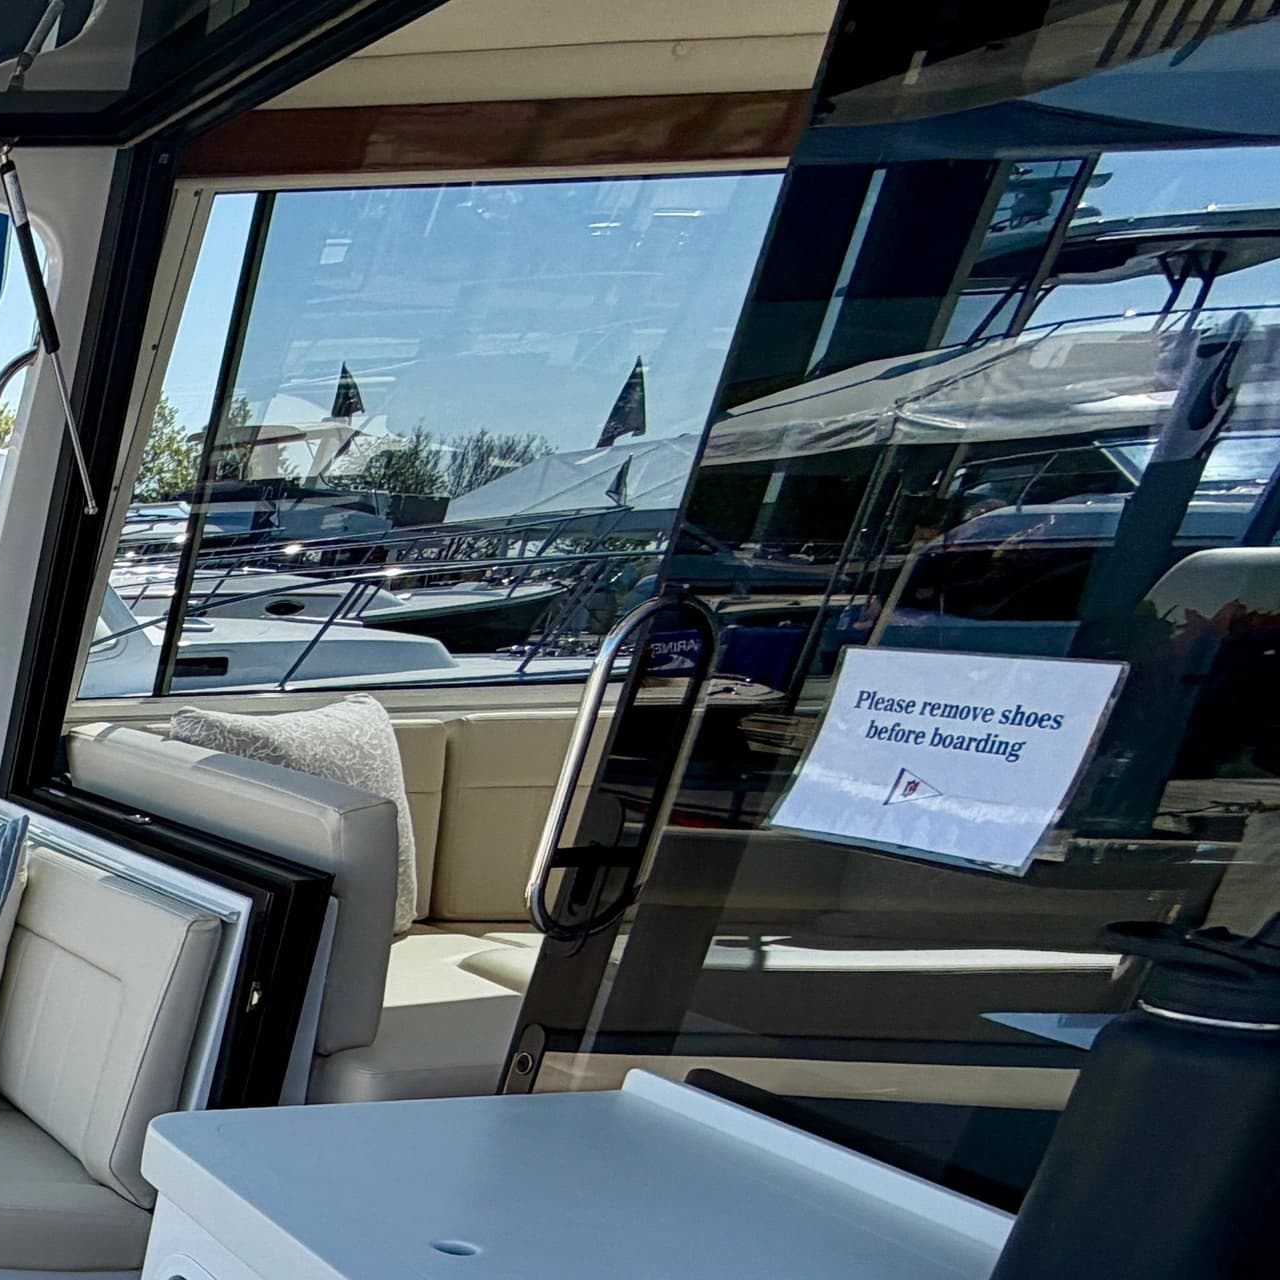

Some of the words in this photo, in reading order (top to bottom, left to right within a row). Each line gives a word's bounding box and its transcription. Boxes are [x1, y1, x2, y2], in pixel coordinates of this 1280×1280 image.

[853, 689, 916, 715] Please
[918, 699, 995, 723] remove
[998, 704, 1065, 731] shoes
[865, 719, 926, 745] before
[929, 727, 1027, 763] boarding
